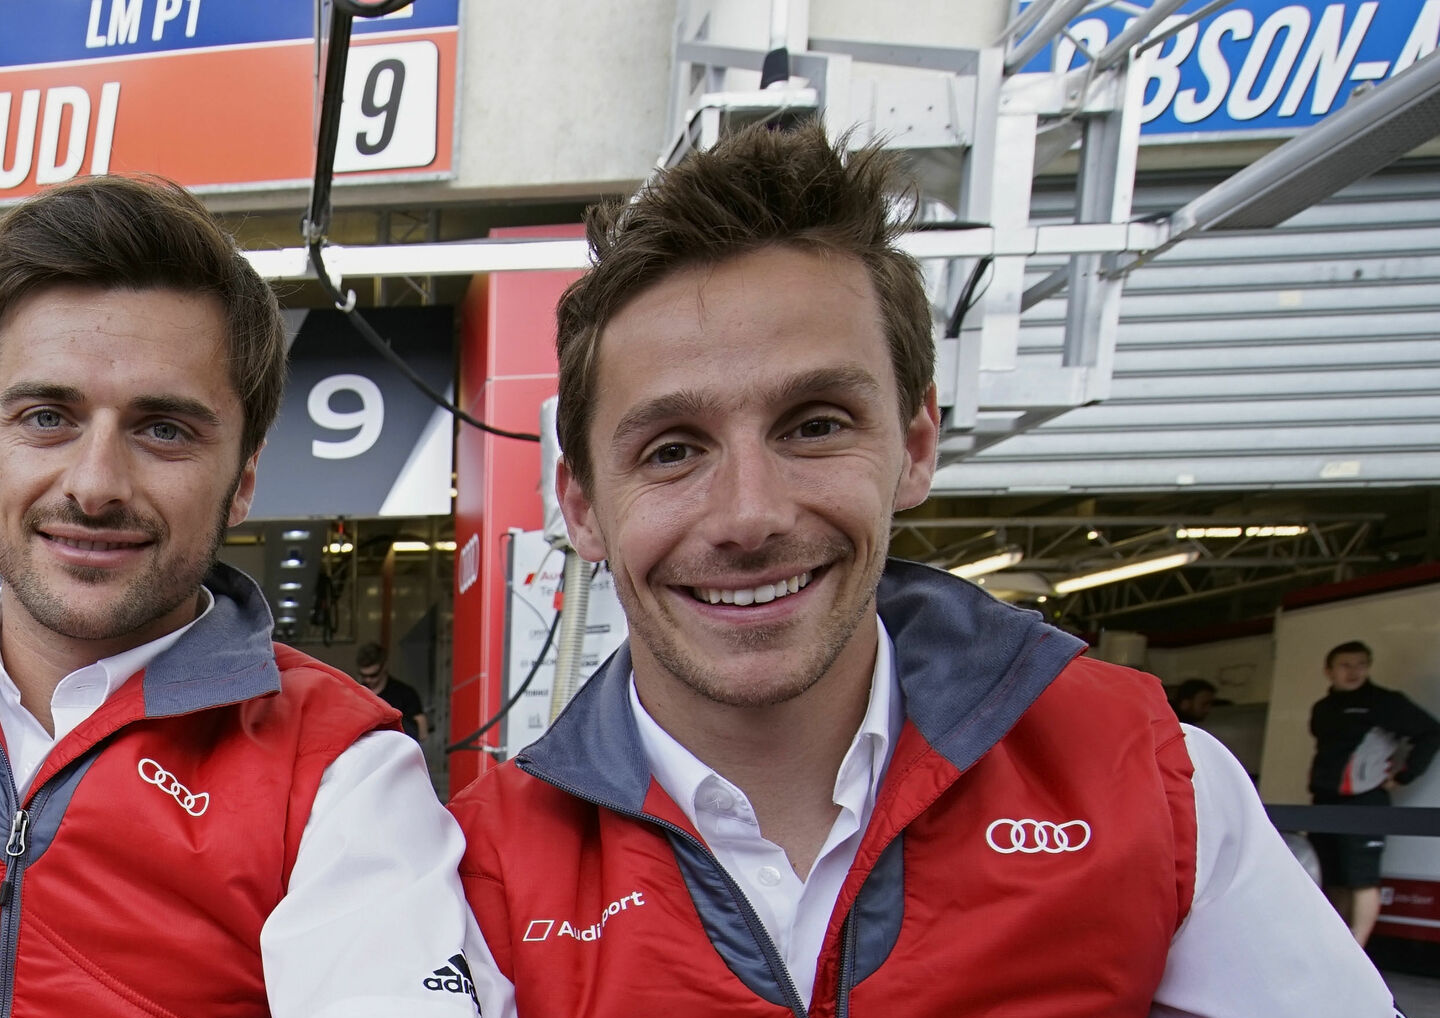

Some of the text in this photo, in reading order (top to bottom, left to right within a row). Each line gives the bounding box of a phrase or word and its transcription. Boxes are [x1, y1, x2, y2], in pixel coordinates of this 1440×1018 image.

[86, 0, 203, 48] LM P1
[356, 58, 406, 156] 9
[307, 373, 385, 460] 9
[601, 891, 646, 928] port
